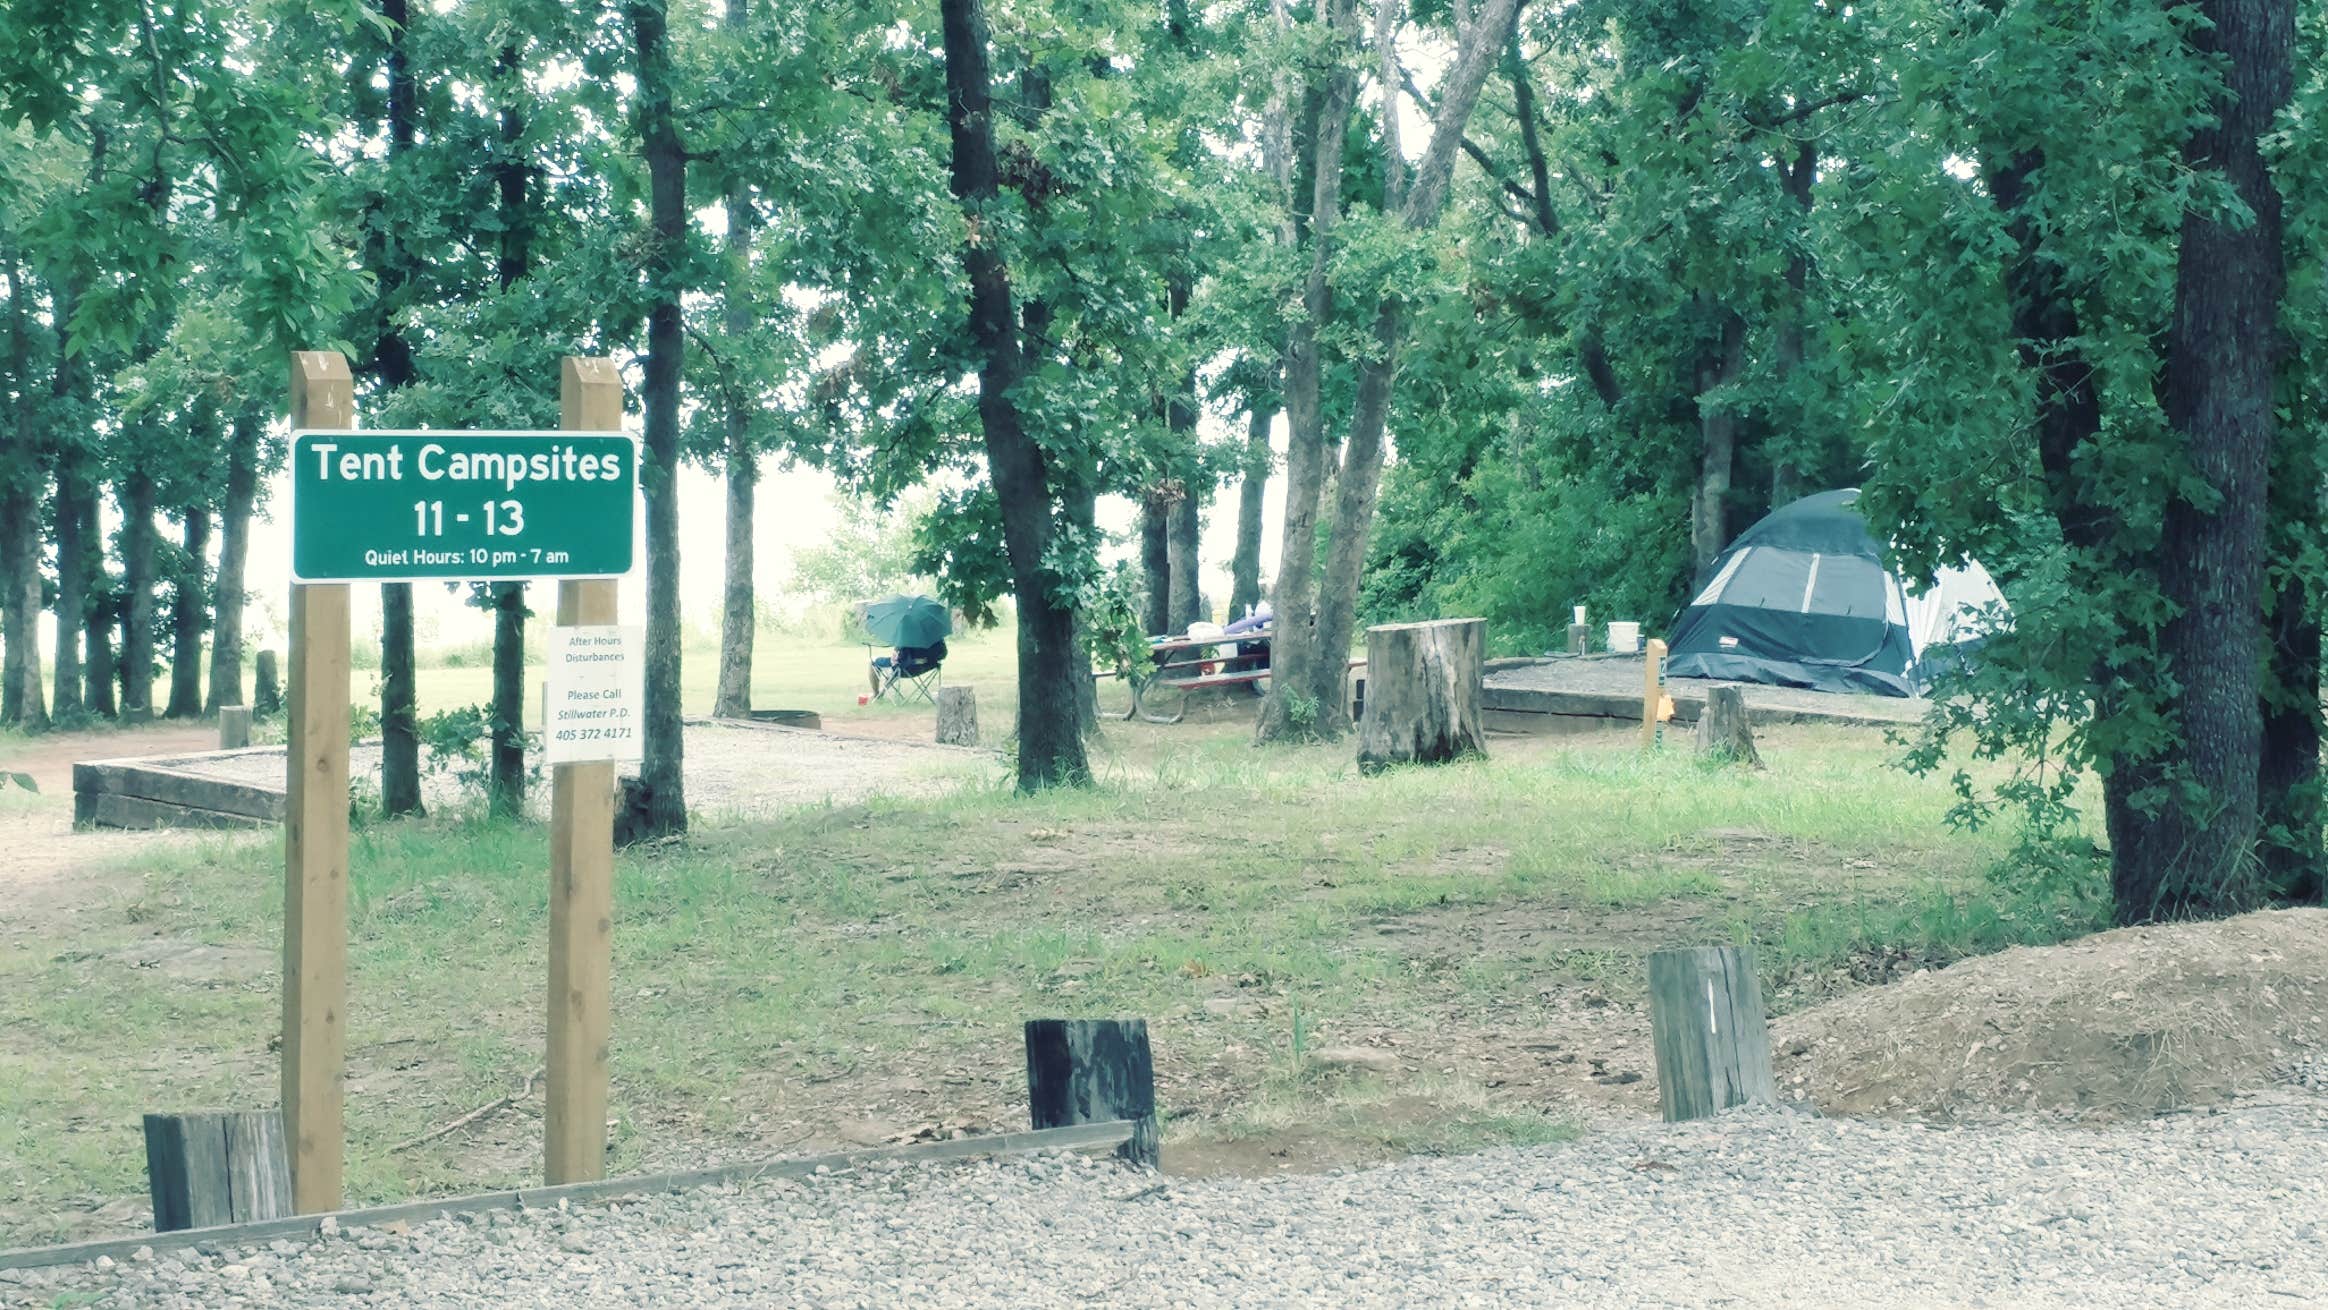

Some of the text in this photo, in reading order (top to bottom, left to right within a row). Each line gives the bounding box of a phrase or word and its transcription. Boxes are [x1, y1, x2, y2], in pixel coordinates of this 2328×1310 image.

[311, 443, 621, 492] Tent Campsites
[414, 499, 525, 537] 11 - 13
[364, 549, 409, 567] Quiet
[413, 549, 465, 565] Hours:
[469, 548, 489, 564] 10
[492, 551, 517, 568] pm
[530, 548, 542, 564] 7
[545, 551, 569, 564] am
[569, 637, 623, 647] After Hours
[565, 652, 625, 663] Disturbances
[567, 688, 622, 701] Please Call
[557, 707, 632, 721] Stillwater P.D.
[555, 727, 632, 741] 405 372 4171
